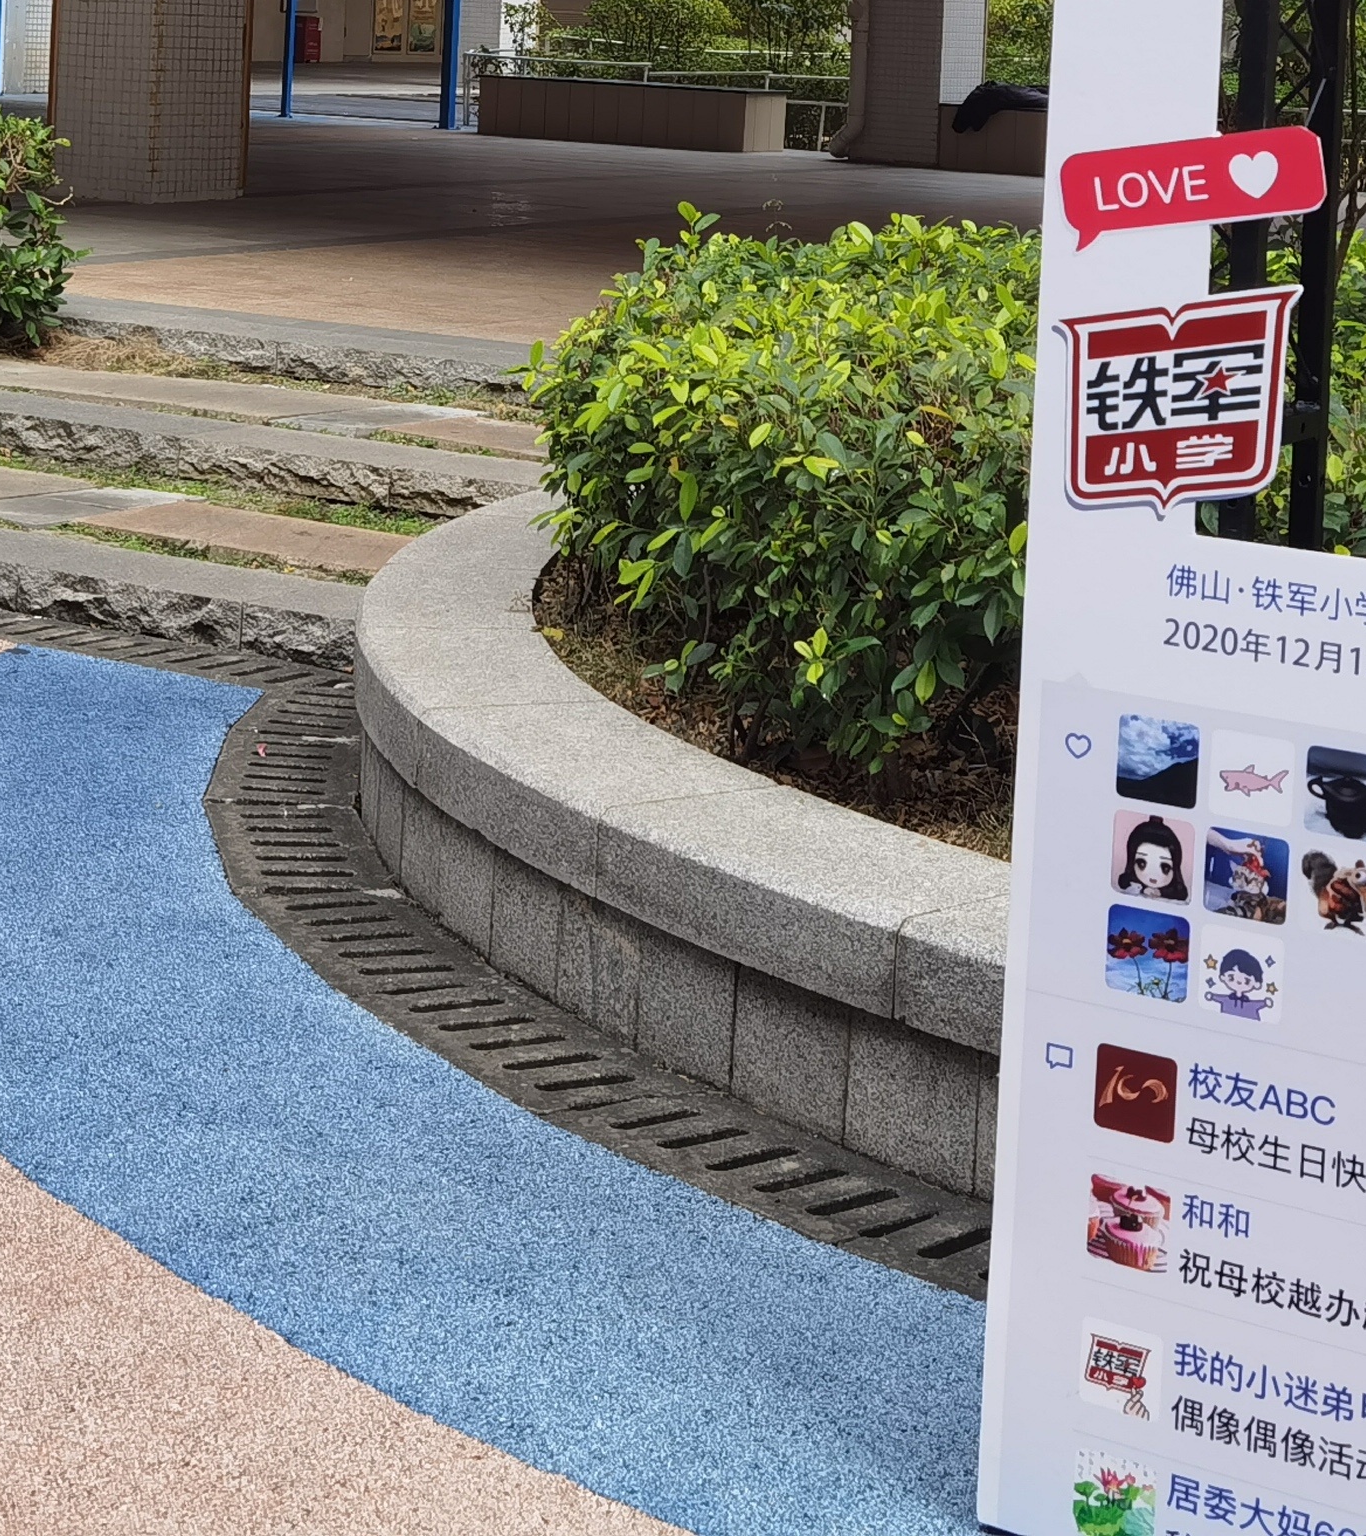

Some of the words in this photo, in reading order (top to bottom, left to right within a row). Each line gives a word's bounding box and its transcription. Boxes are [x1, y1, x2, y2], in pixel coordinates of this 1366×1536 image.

[1093, 164, 1209, 211] LOVE
[1086, 343, 1265, 431] 铁军
[1104, 434, 1233, 477] 小学
[1186, 1062, 1337, 1126] 校友ABC
[1181, 1193, 1252, 1240] 和和
